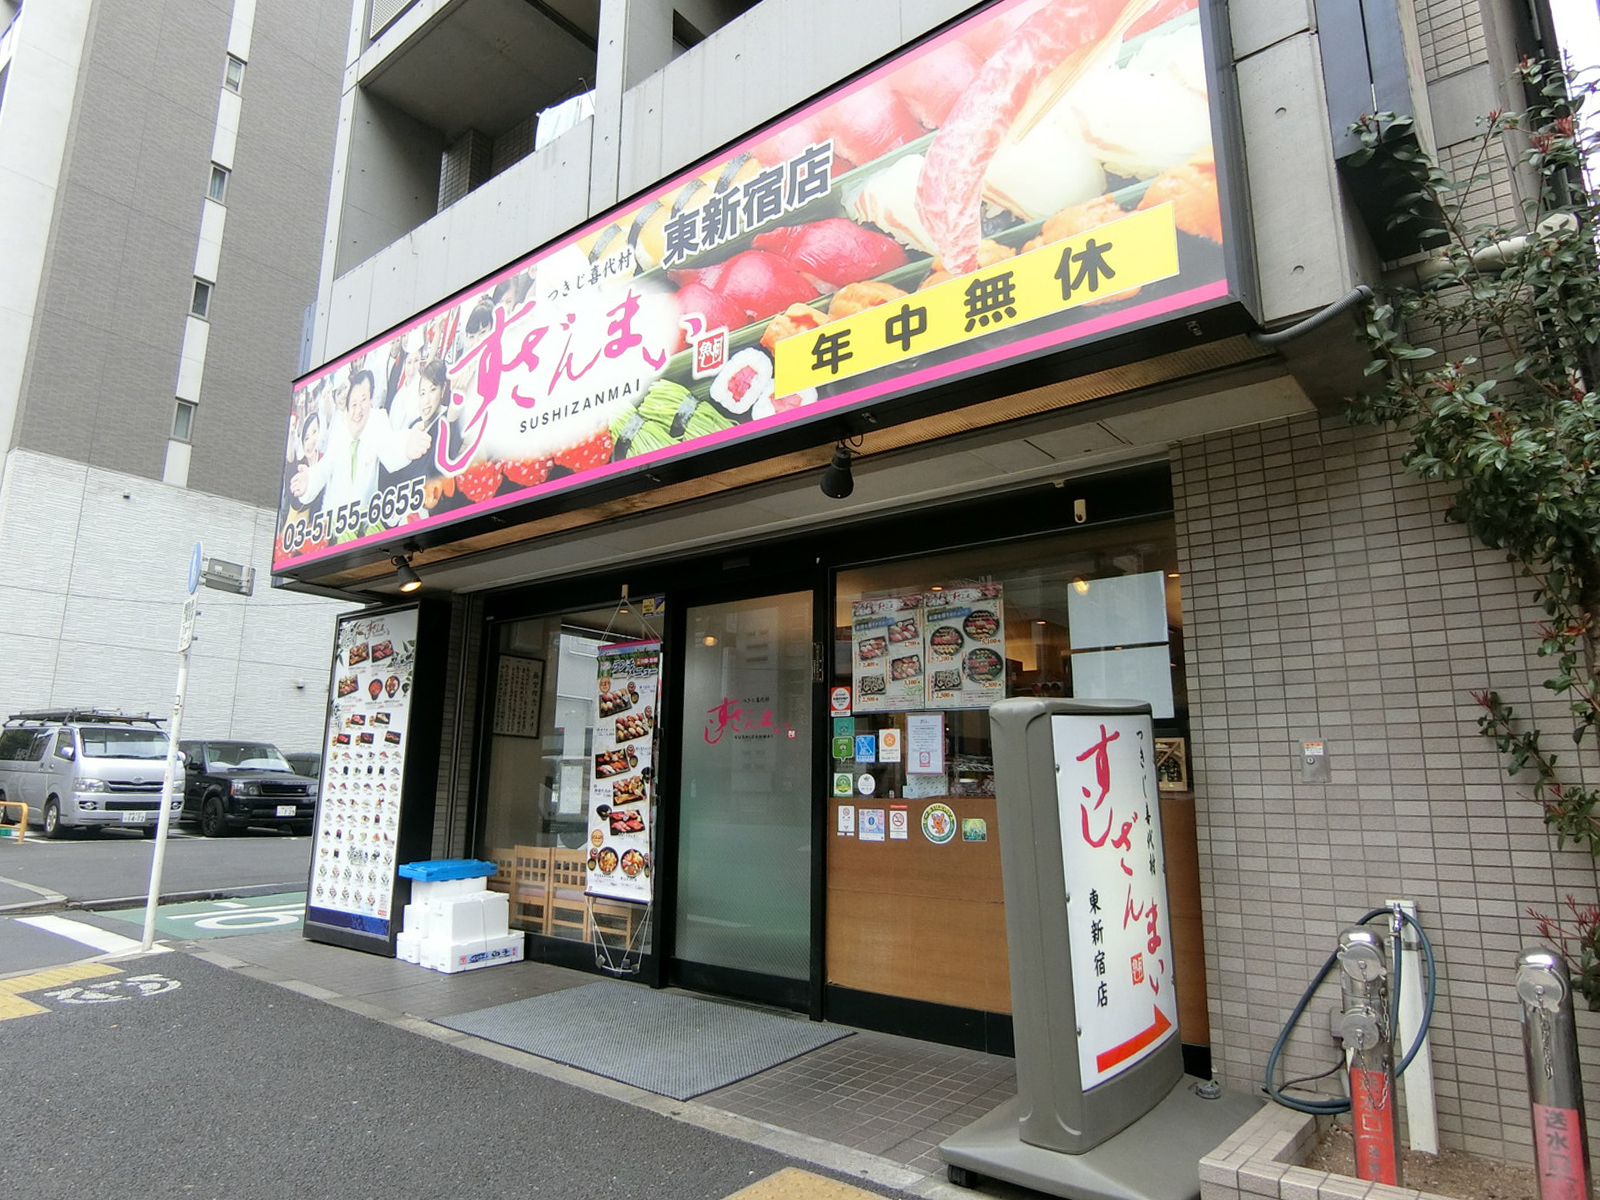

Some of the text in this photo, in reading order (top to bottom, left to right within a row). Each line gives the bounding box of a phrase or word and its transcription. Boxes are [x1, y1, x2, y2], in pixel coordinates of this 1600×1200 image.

[664, 142, 833, 266] 東新宿店
[547, 249, 634, 302] つきじ喜代村
[810, 238, 1116, 375] 年中無休
[437, 288, 703, 473] すしざんまい
[519, 378, 641, 434] SUSHIZANMAI
[283, 477, 426, 551] 03-5155-6655
[1076, 723, 1165, 996] すしざんまい
[1135, 729, 1157, 878] つきじ喜代村
[1088, 887, 1110, 1009] 東新宿店
[1543, 1109, 1573, 1174] 送水口
